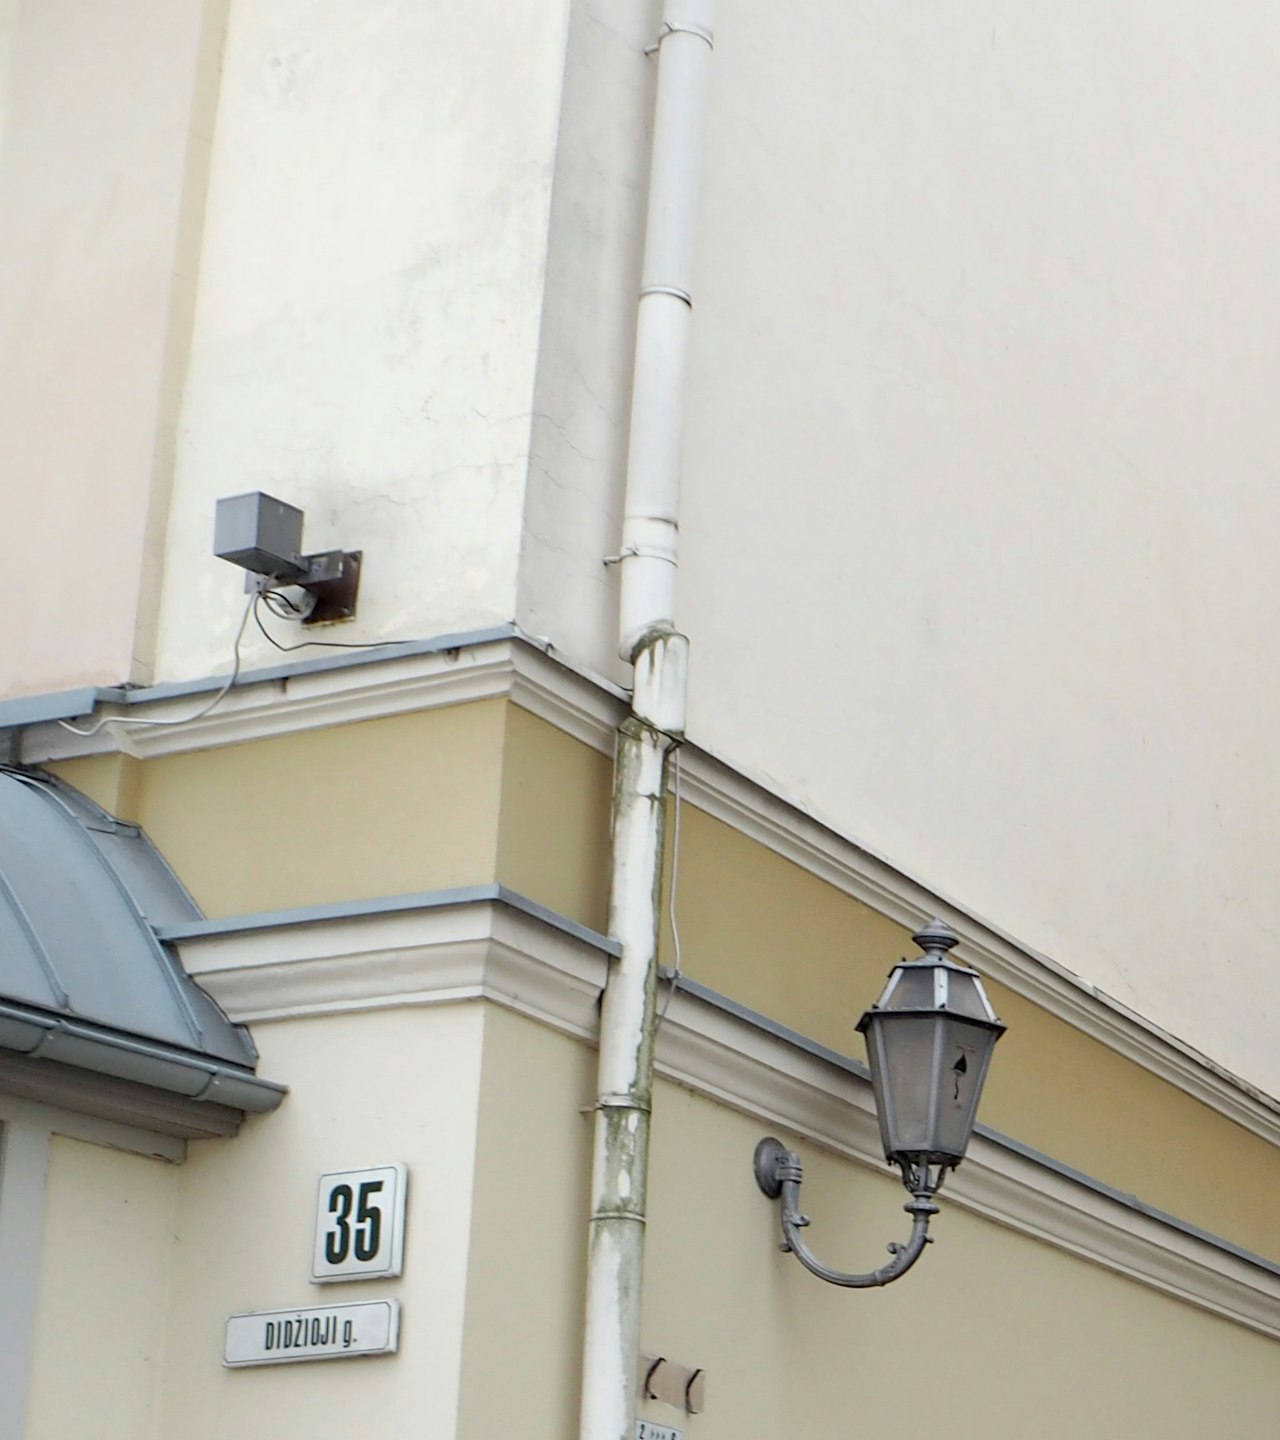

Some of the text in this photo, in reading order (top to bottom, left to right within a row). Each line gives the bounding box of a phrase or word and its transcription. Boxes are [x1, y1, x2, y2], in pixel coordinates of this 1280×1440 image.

[325, 1180, 385, 1265] 35
[264, 1313, 358, 1351] DIDŽIOJI g.
